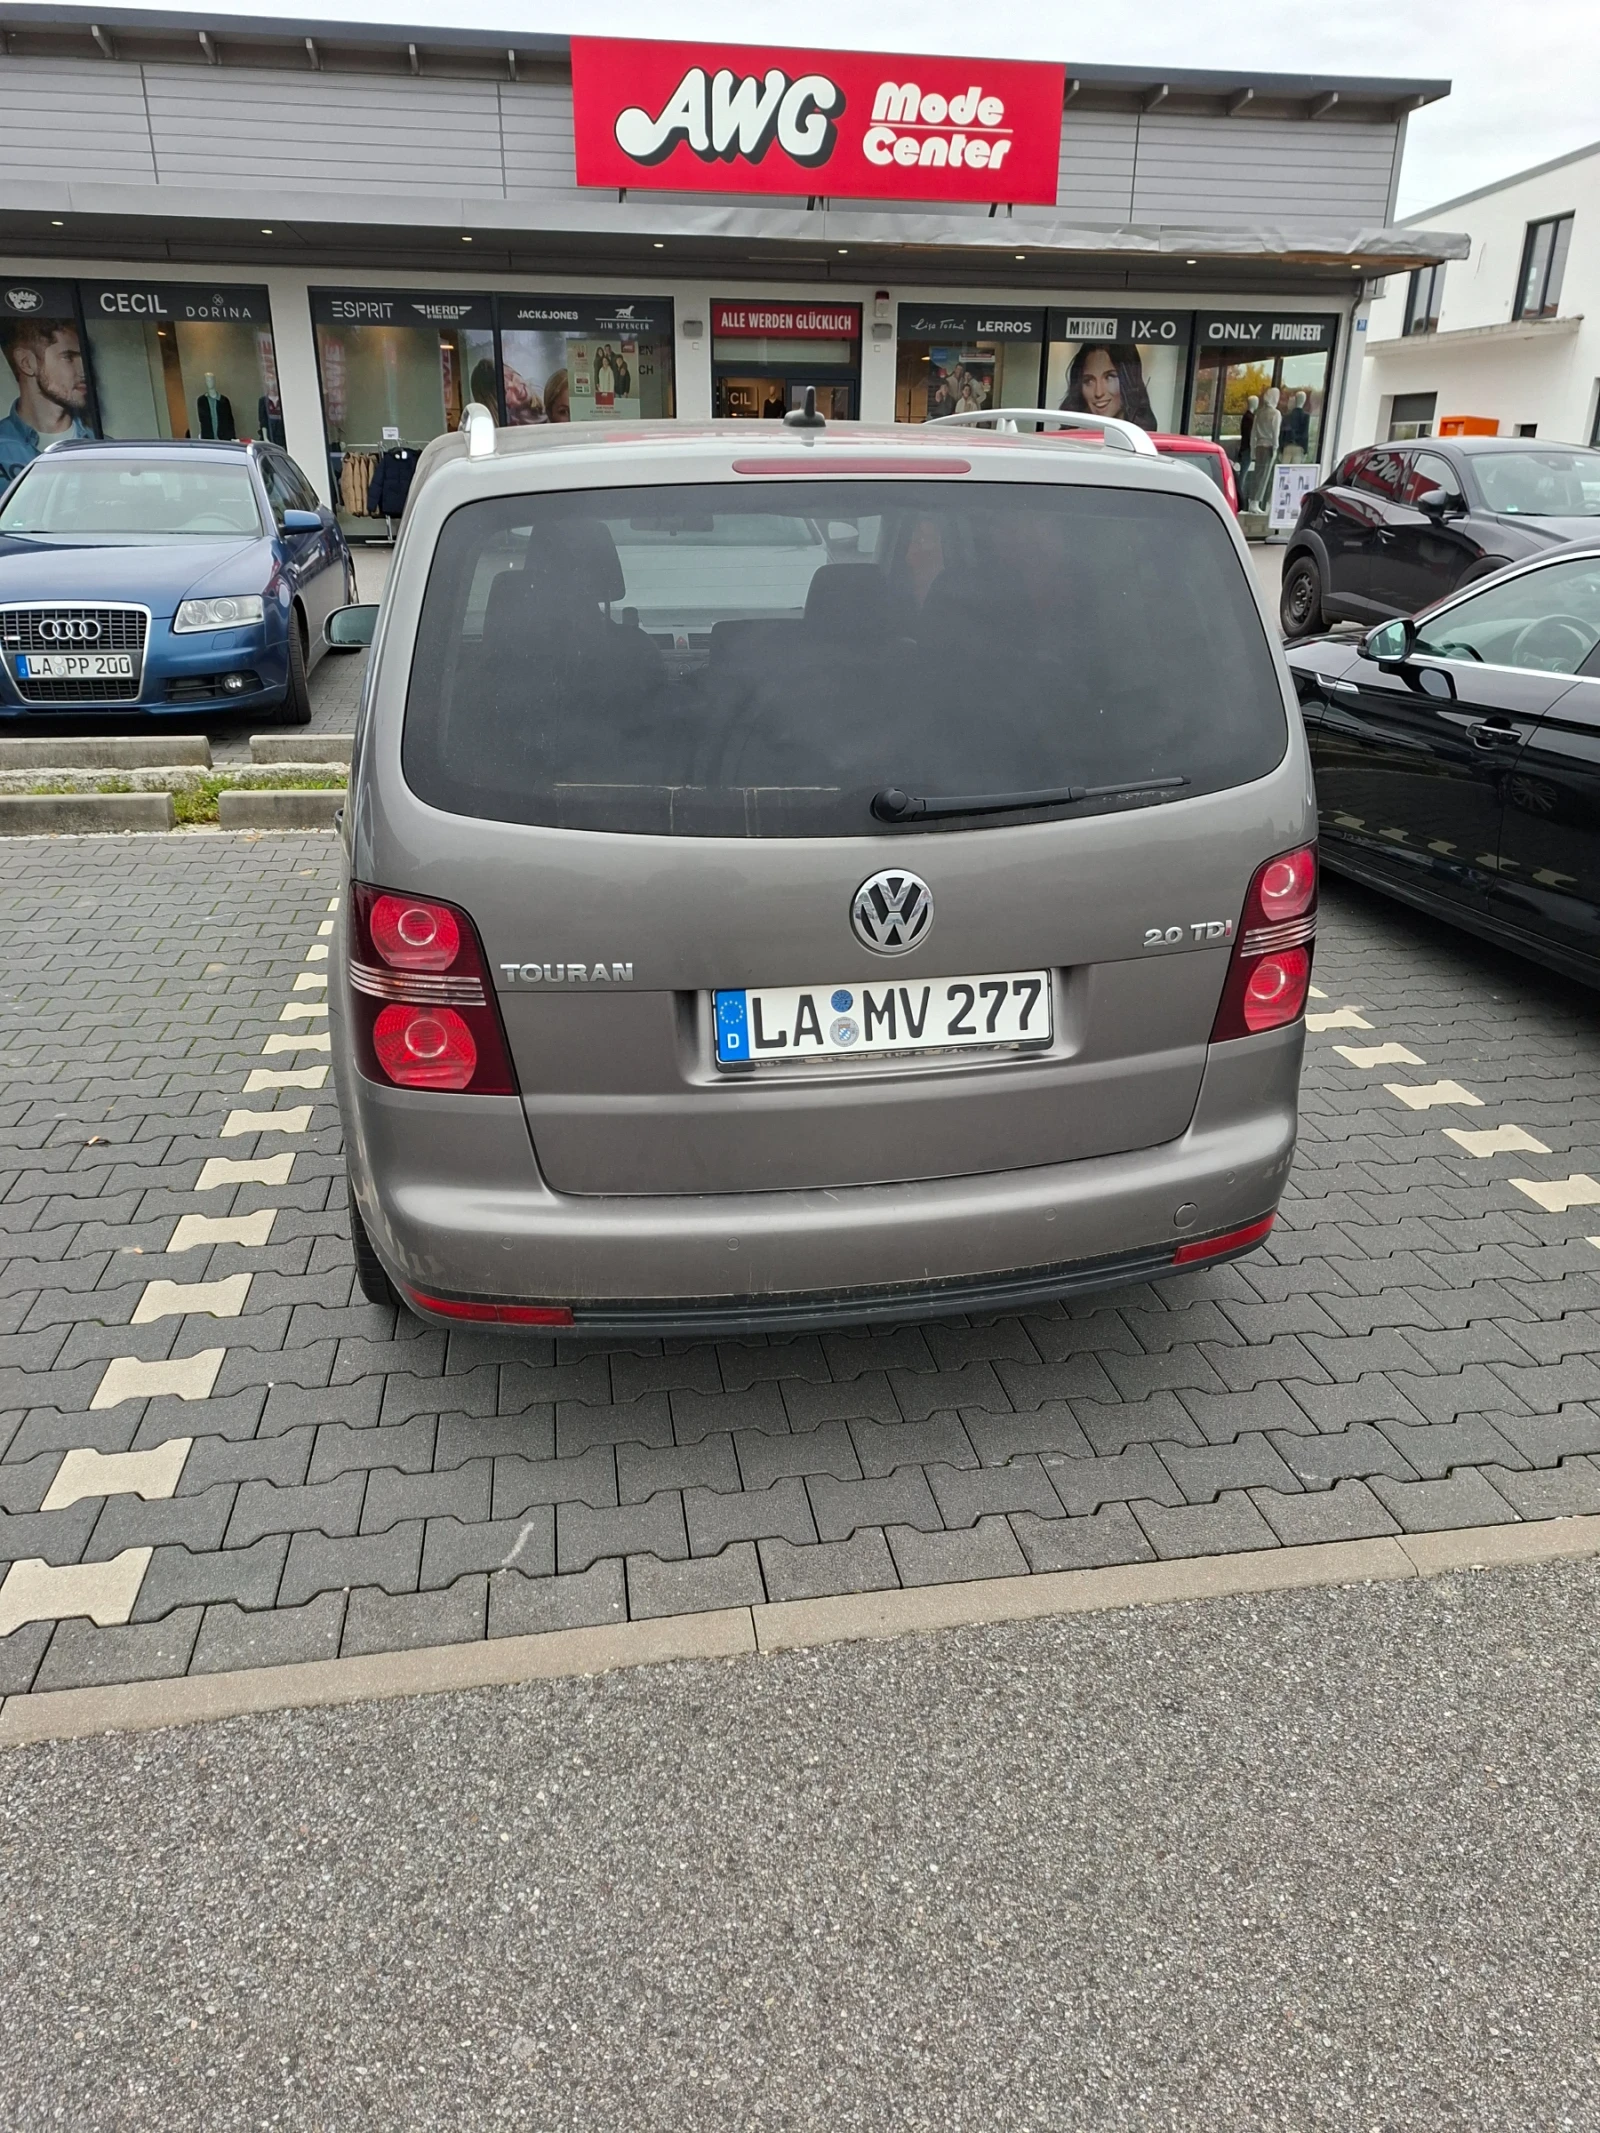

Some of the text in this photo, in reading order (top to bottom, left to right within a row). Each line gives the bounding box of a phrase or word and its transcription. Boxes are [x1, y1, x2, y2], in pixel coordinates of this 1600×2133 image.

[871, 81, 1005, 127] Mode
[614, 66, 846, 168] AWG
[862, 126, 1013, 169] Center
[100, 292, 168, 314] CECIL
[186, 306, 252, 318] DORINA
[331, 301, 394, 319] ESPRIT
[426, 304, 459, 315] HERO
[517, 309, 579, 321] JACK&JONES
[721, 311, 852, 331] ALLE WERDEN GLÜCKLICH
[600, 321, 650, 331] JIM SPENCER
[977, 320, 1032, 334] LERROS
[1130, 320, 1177, 339] IX-O
[1208, 322, 1262, 340] ONLY
[1271, 323, 1321, 341] PIONEER
[28, 657, 131, 675] LA PP 200
[1190, 919, 1232, 941] TDI
[499, 962, 634, 983] TOURAN
[751, 994, 824, 1049] LA
[862, 986, 931, 1042] MV
[946, 978, 1042, 1036] 277
[727, 1033, 740, 1049] D
